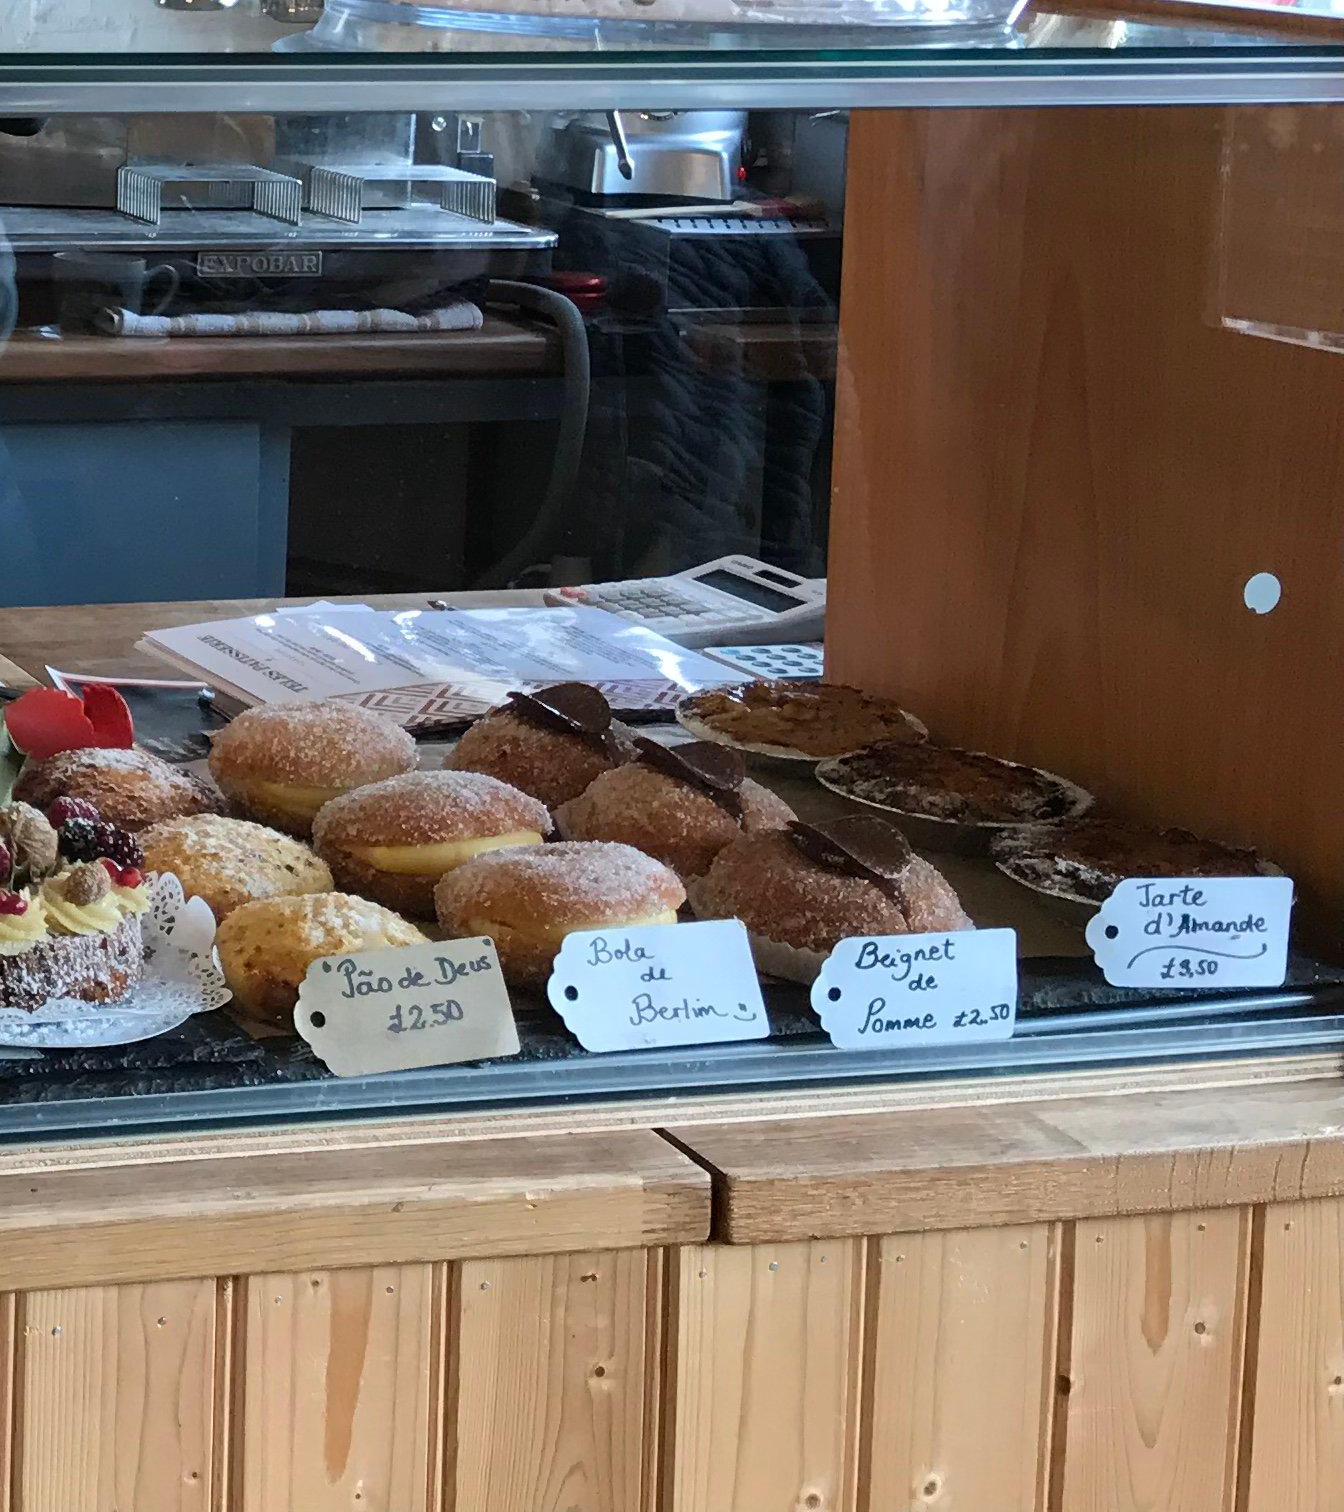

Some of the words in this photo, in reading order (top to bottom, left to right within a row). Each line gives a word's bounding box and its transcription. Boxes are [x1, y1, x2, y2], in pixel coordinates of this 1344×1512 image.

[202, 254, 318, 273] EXPOBAR
[1134, 882, 1208, 909] Tarte
[1143, 910, 1269, 941] d'Amande
[587, 935, 656, 966] Bola
[854, 938, 956, 982] Beignet
[336, 957, 393, 1000] Pão
[399, 962, 432, 990] de
[433, 954, 493, 987] Deus
[640, 963, 673, 984] de
[908, 969, 939, 993] de
[858, 997, 939, 1036] Pomme
